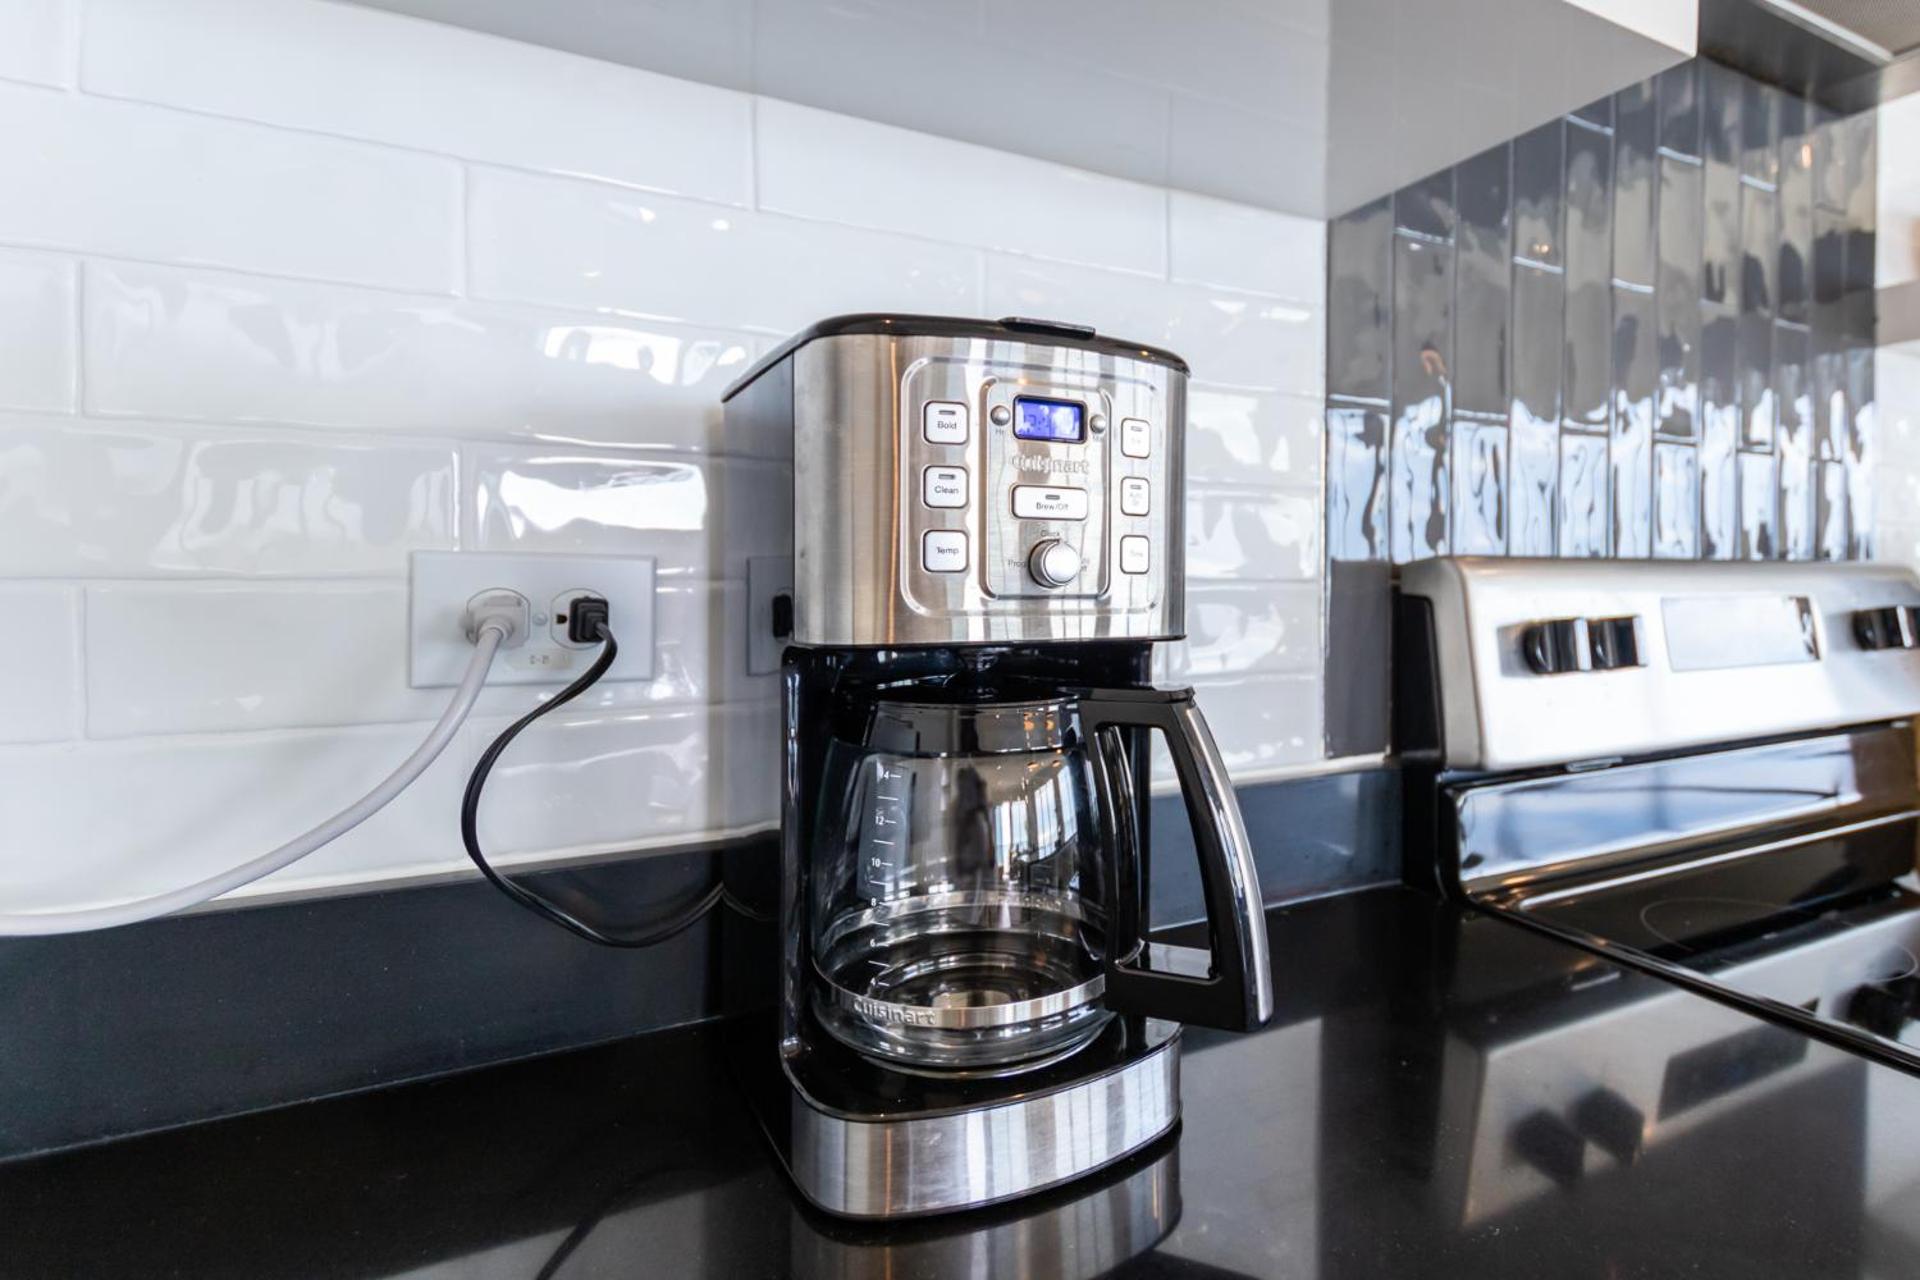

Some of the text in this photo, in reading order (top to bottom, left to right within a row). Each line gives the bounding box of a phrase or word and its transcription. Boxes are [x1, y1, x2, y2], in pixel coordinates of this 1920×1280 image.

[937, 420, 957, 430] Bold
[934, 485, 960, 494] Clean
[936, 546, 960, 556] Temp
[875, 815, 885, 825] 12
[871, 857, 881, 868] 10
[871, 897, 877, 907] 8
[869, 938, 876, 948] 6
[853, 999, 937, 1025] Cuisinart
